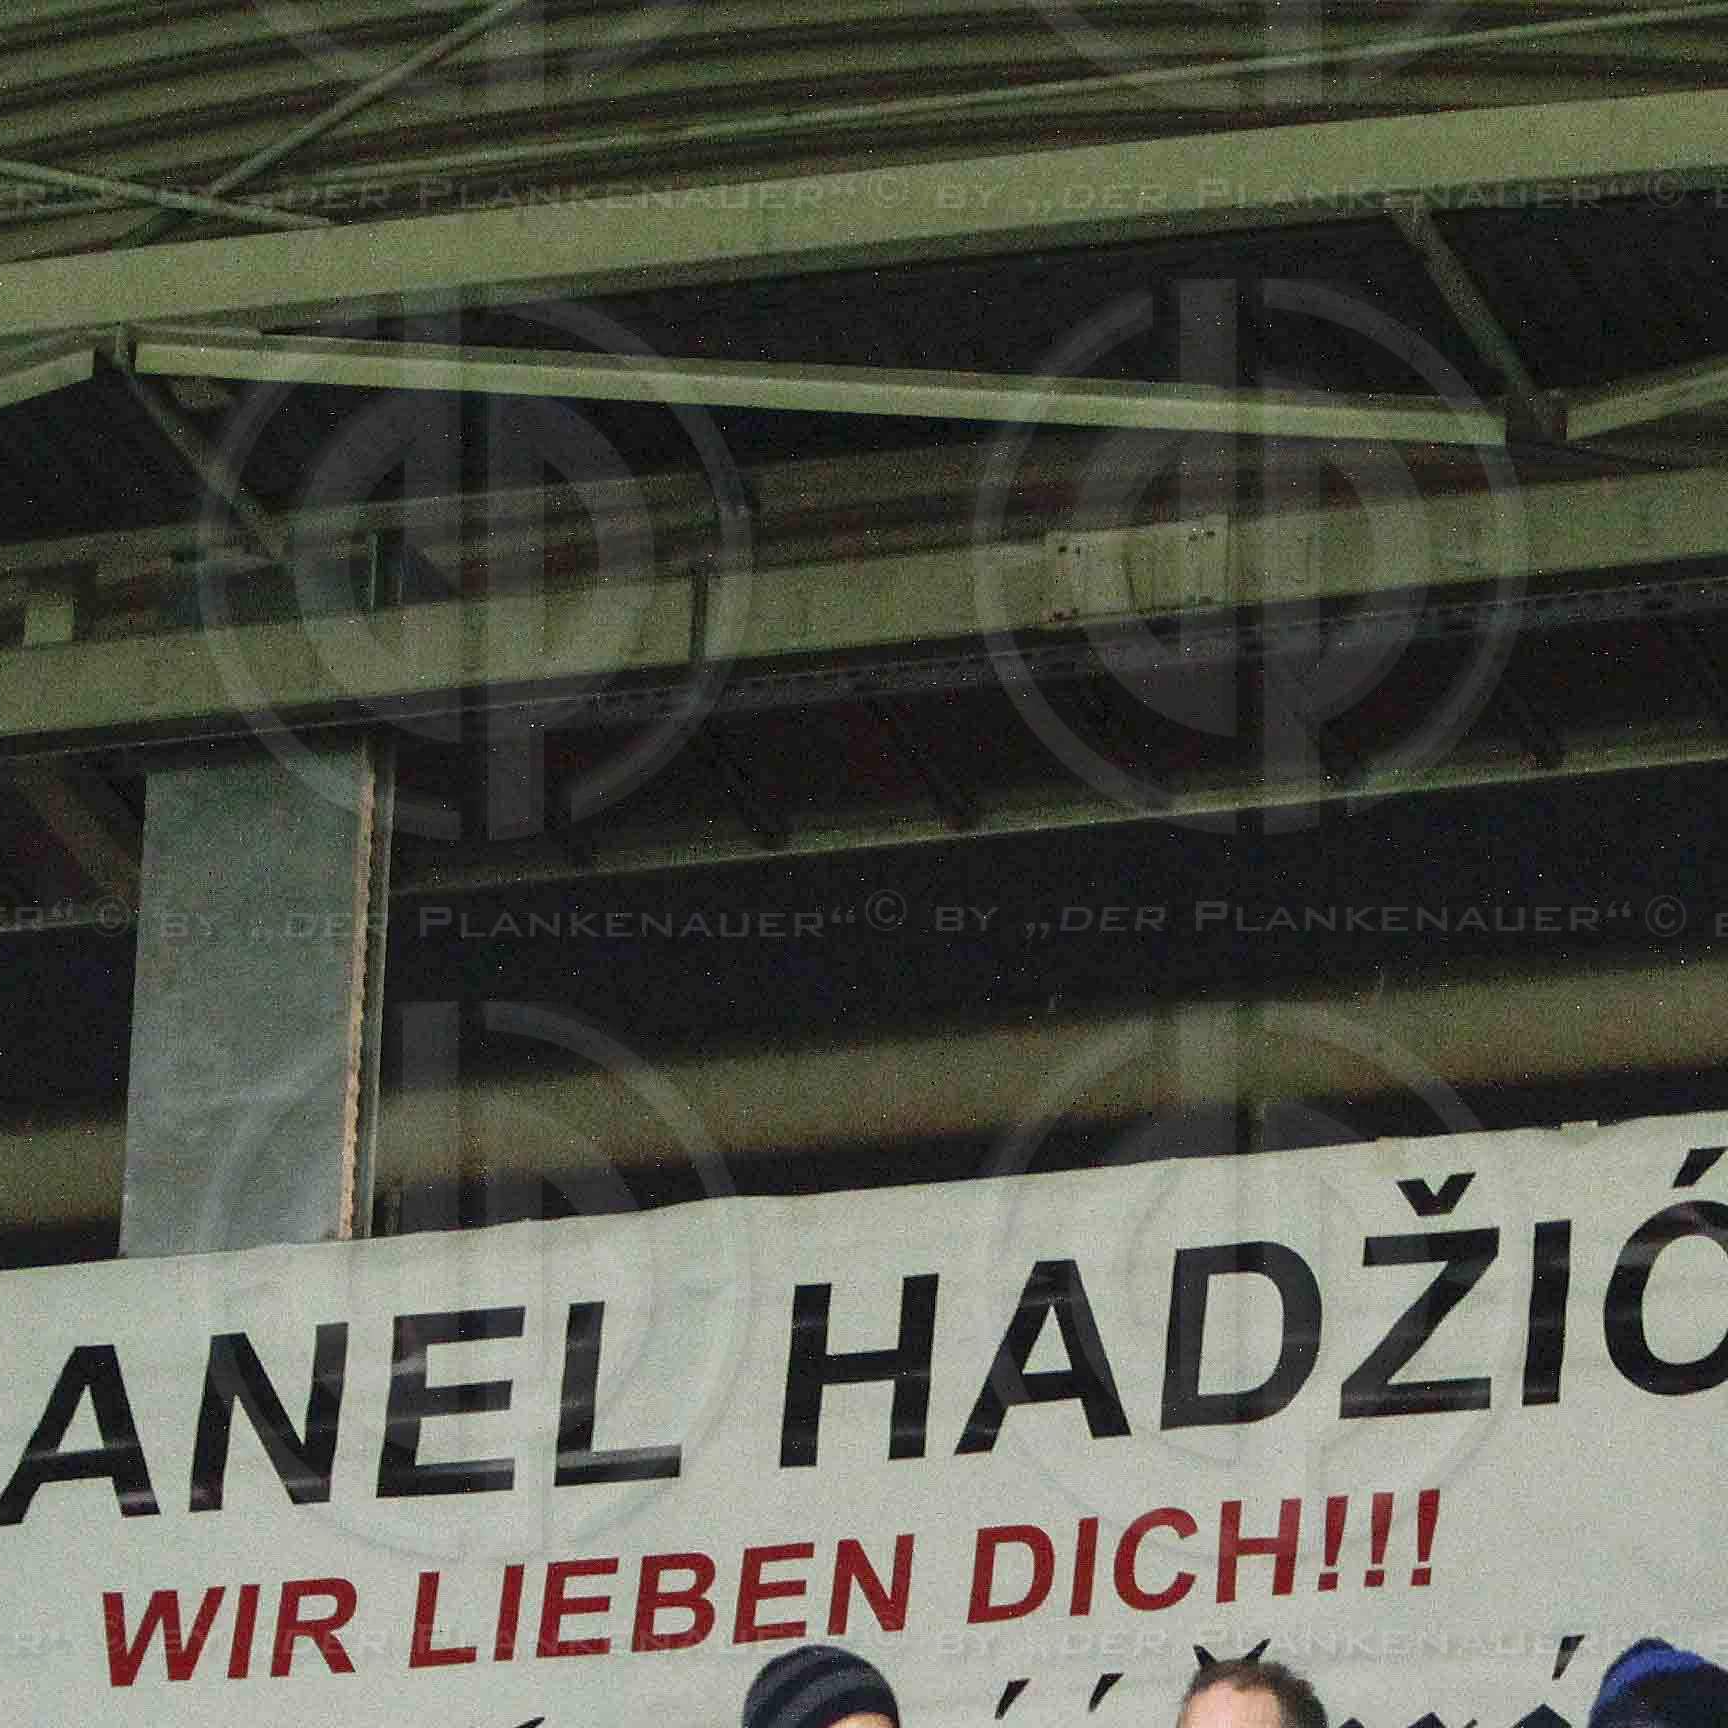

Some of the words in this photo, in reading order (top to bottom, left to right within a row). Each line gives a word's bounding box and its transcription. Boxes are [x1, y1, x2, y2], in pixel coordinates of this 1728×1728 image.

[104, 1579, 357, 1688] WIR
[410, 1536, 913, 1668] LIEBEN
[968, 1490, 1440, 1623] DICH!!!
